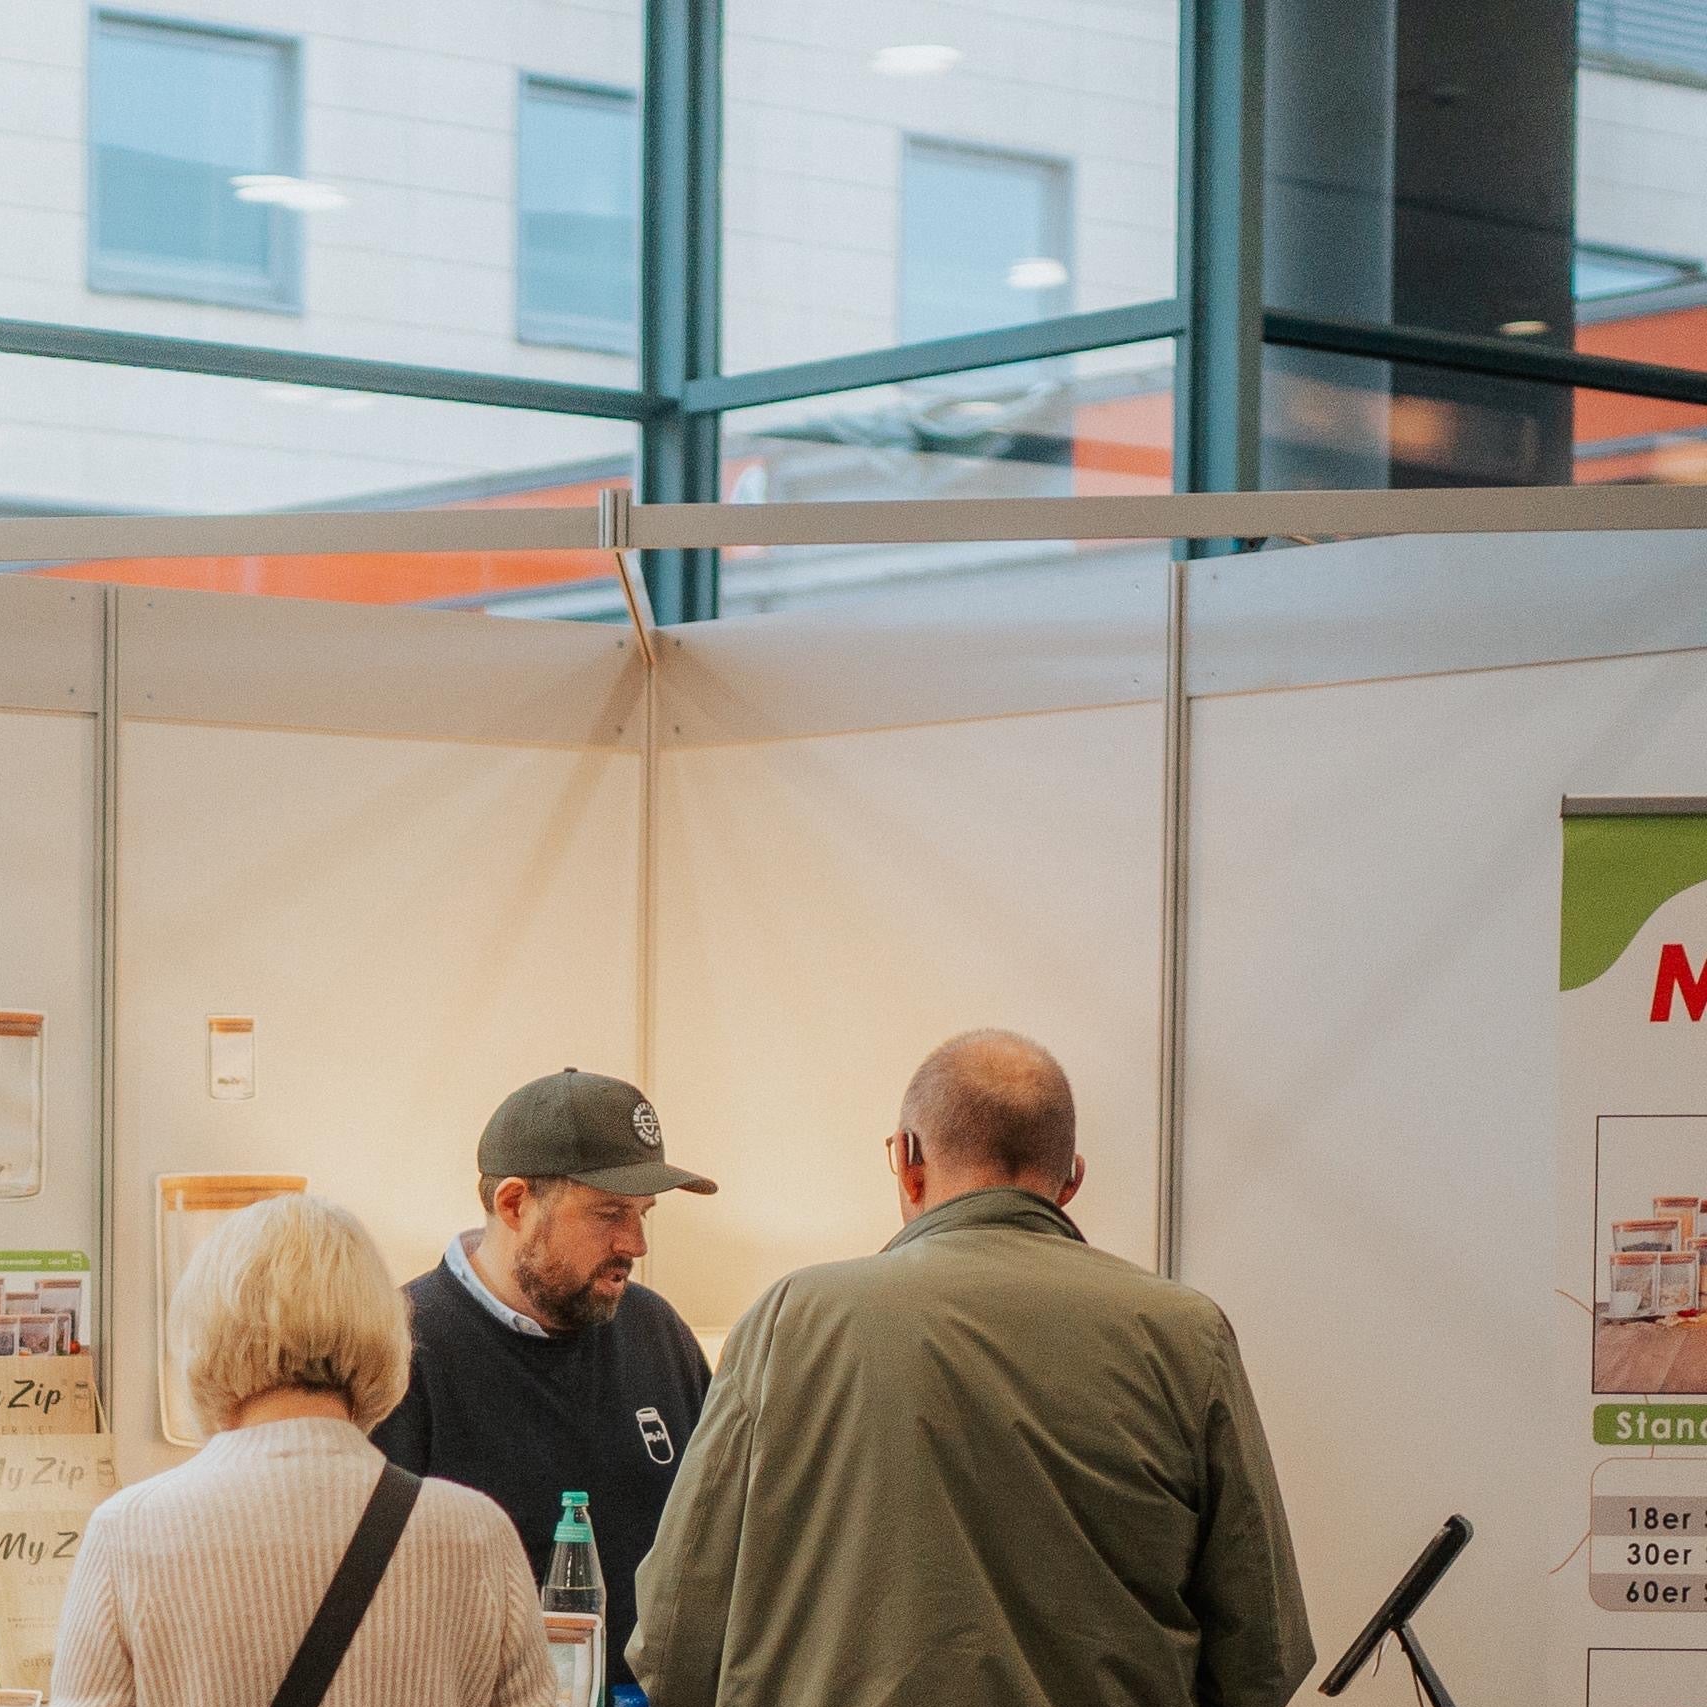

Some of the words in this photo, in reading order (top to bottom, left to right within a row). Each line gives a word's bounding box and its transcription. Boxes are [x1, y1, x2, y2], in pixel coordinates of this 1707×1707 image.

[1627, 1506, 1691, 1530] 18er
[1626, 1543, 1692, 1566] 30er
[1626, 1580, 1691, 1604] 60er
